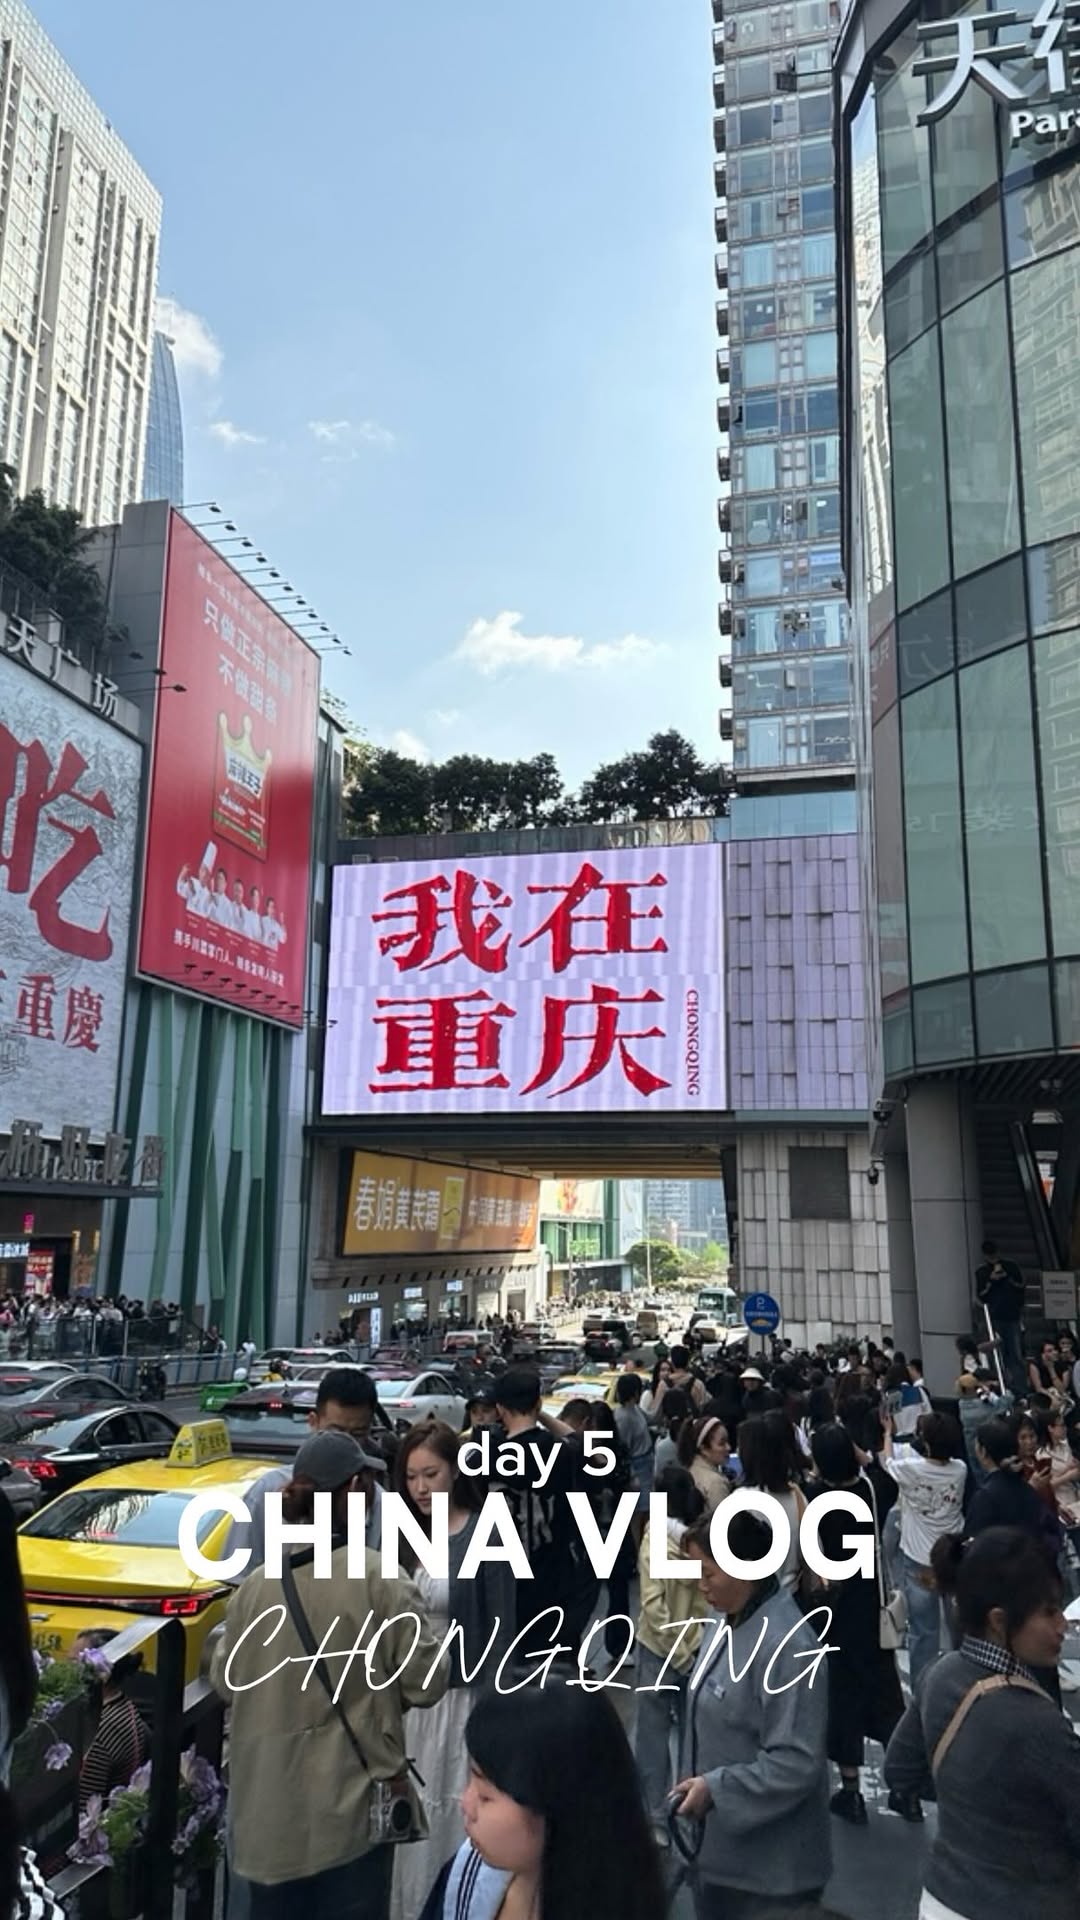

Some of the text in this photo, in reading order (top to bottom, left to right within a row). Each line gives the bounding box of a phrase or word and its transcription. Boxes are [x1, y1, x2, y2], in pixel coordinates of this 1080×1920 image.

[371, 863, 668, 974] 我在
[0, 968, 105, 1053] 重慶
[369, 984, 672, 1099] 重庆
[685, 989, 700, 1096] CHONGQING
